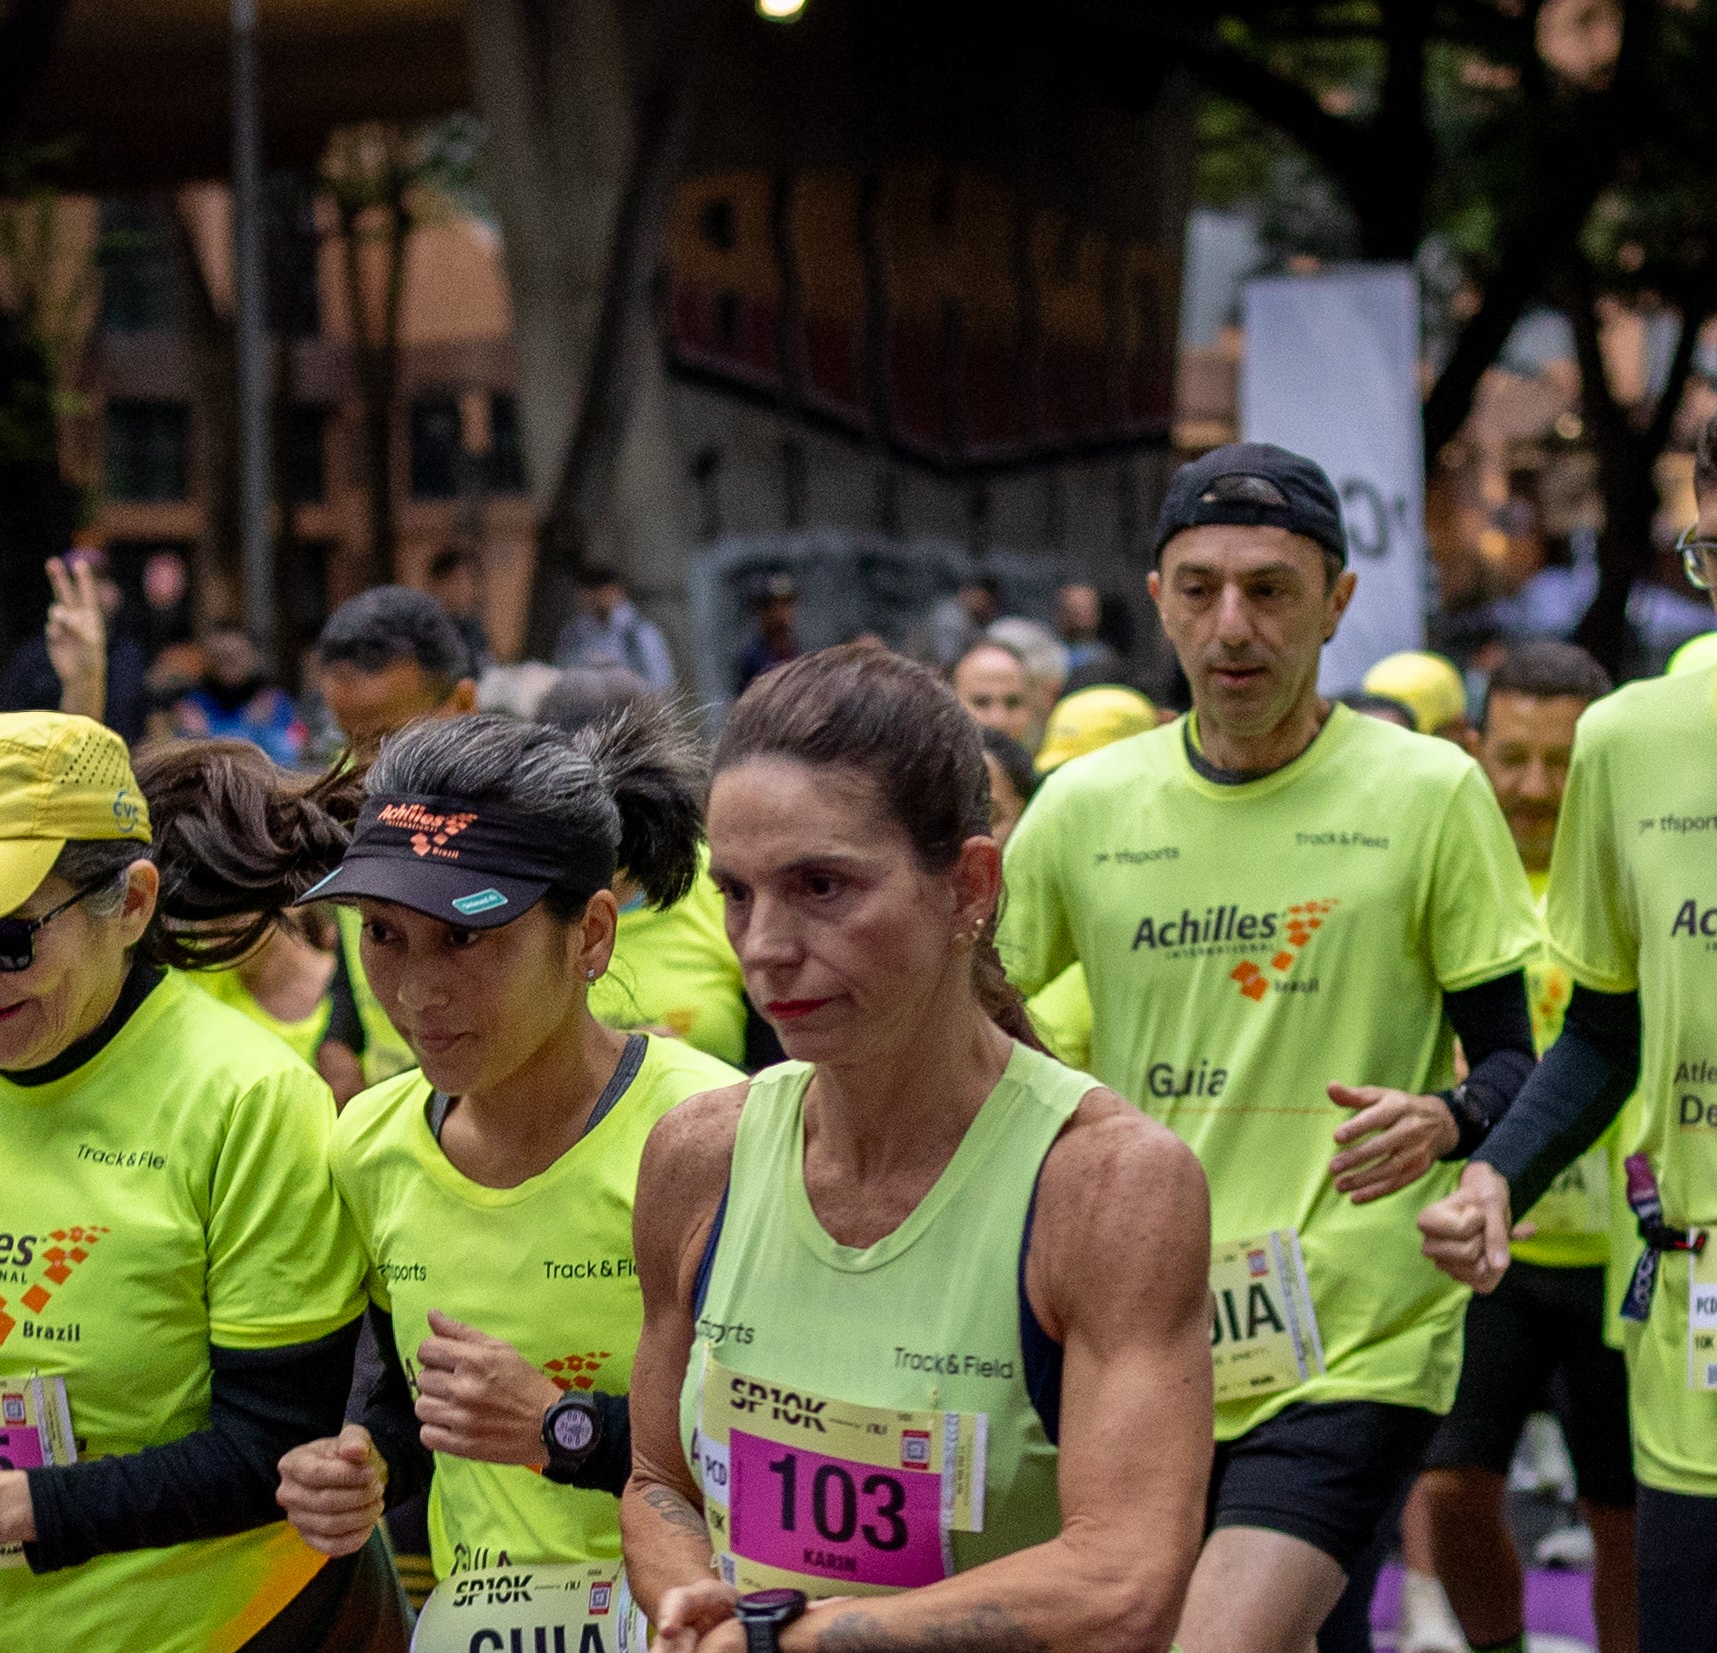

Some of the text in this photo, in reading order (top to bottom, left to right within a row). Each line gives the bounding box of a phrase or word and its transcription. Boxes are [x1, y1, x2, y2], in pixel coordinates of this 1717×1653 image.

[377, 803, 445, 827] Achilles
[1132, 905, 1278, 951] Achilles
[1696, 1297, 1717, 1315] PCD
[23, 1320, 81, 1342] Brazil
[730, 1378, 828, 1433] SP10K
[770, 1453, 909, 1551] 103
[804, 1549, 857, 1573] KARIN
[453, 1574, 533, 1608] SP10K
